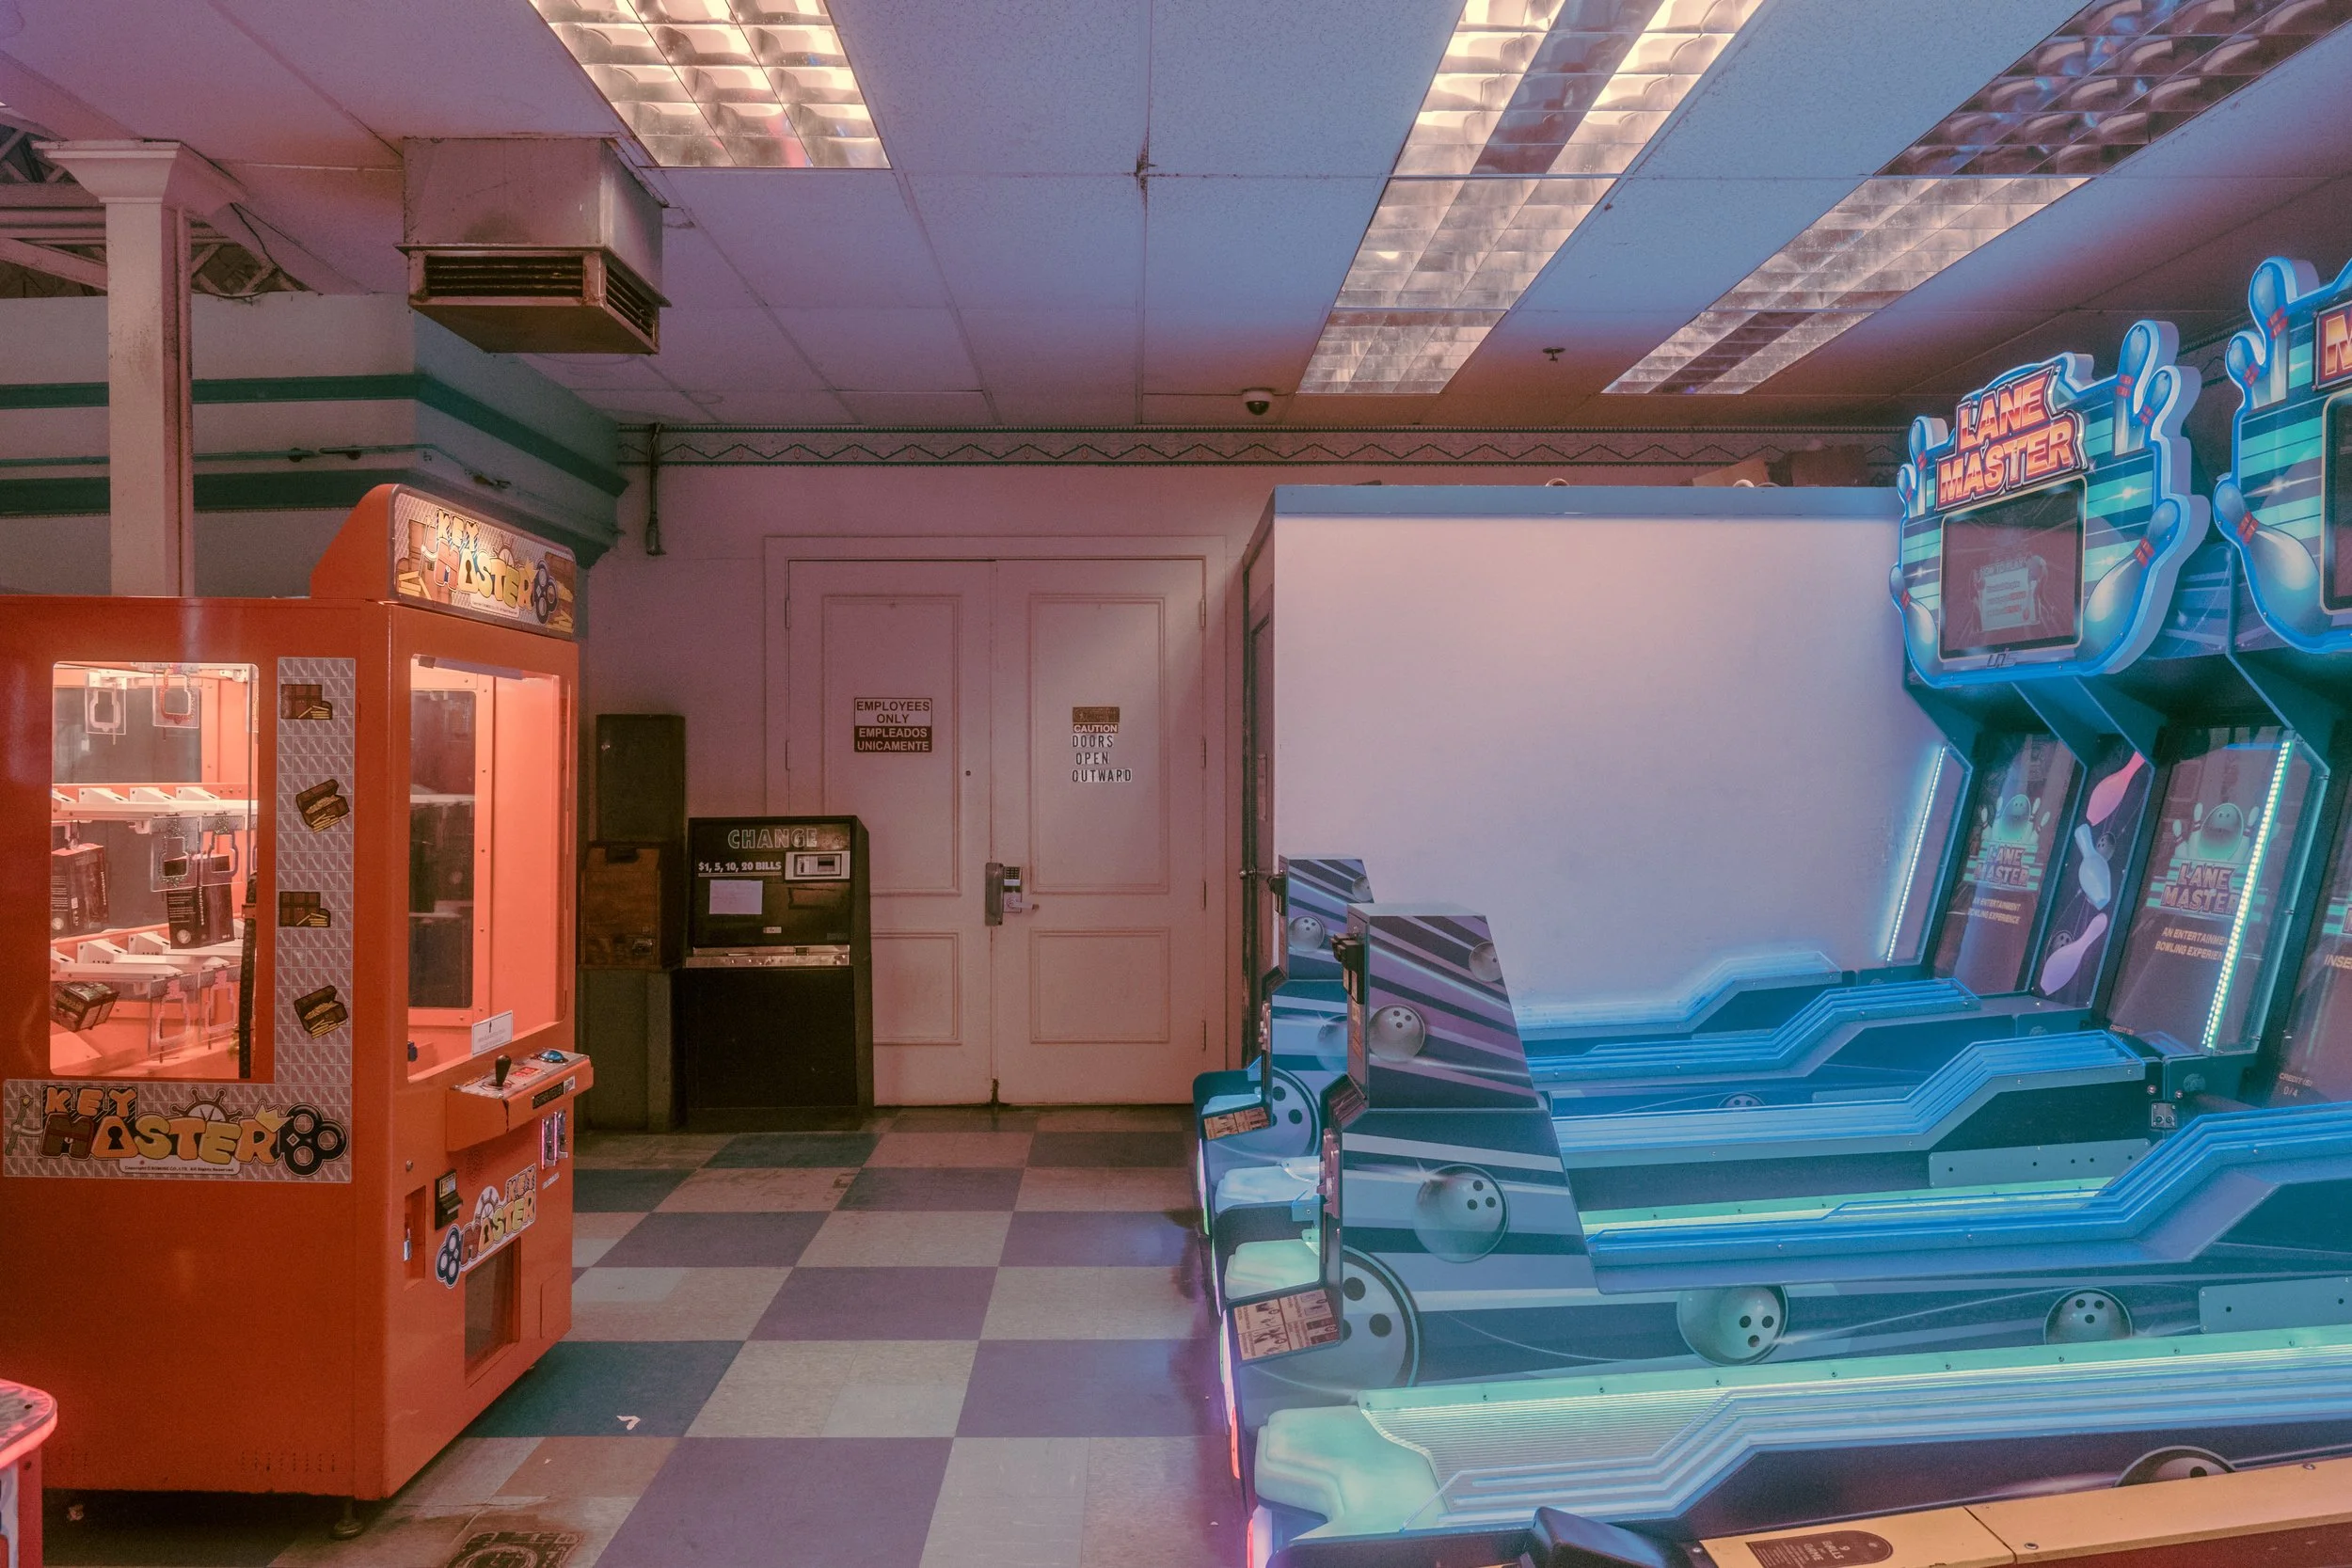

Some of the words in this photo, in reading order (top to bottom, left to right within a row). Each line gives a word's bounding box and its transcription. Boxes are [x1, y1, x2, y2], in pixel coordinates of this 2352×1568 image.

[1958, 376, 2047, 451] LANE
[1939, 420, 2074, 503] MASTER
[437, 509, 479, 551] KEY
[434, 538, 536, 612] MASTER
[856, 701, 930, 711] EMPLOYEES
[876, 713, 910, 723] ONLY
[859, 728, 928, 737] EMPLEADOS
[1073, 724, 1118, 733] CAUTION
[857, 740, 930, 751] UNICAMENTE
[1073, 735, 1113, 748] DOORS
[1075, 752, 1108, 765] OPEN
[1073, 768, 1132, 782] OUTWARD
[727, 828, 818, 848] CHANGE
[698, 862, 712, 873] $1,
[714, 862, 723, 872] 5,
[725, 862, 739, 872] 10,
[741, 862, 753, 871] 20
[755, 861, 782, 871] BILLS
[2177, 863, 2233, 890] LANE
[2162, 927, 2172, 937] AN
[2155, 941, 2187, 955] BOWLING
[2187, 946, 2222, 961] EXPERIEN
[2324, 954, 2352, 970] INSE
[45, 1086, 137, 1117] KEY
[40, 1111, 278, 1165] MASTER
[508, 1168, 535, 1202] KEY
[461, 1189, 536, 1266] MASTER
